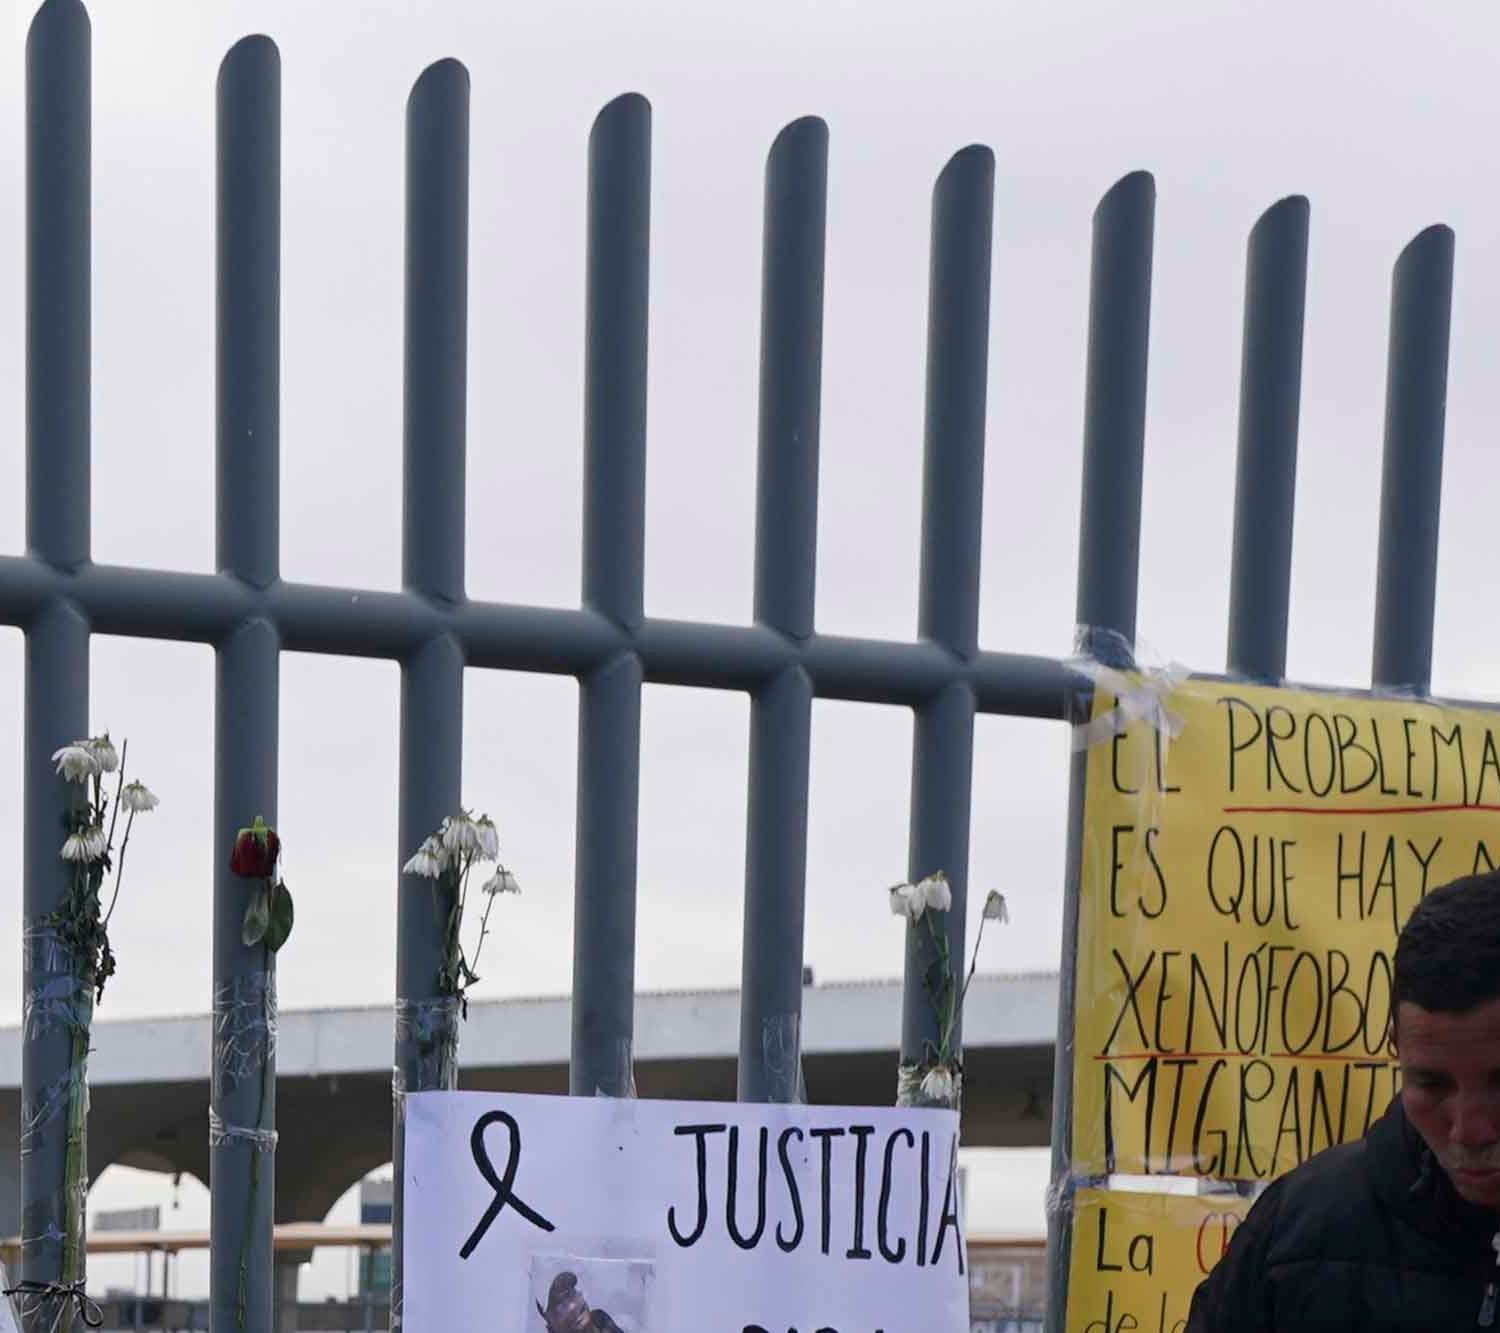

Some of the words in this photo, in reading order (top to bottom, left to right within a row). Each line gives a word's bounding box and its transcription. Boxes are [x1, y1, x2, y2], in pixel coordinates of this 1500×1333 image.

[1110, 696, 1181, 796] EL
[1109, 824, 1168, 921] ES
[1206, 825, 1300, 931] QUE
[1337, 830, 1444, 937] HAY
[1102, 941, 1399, 1058] XENÓFOBO
[666, 1124, 966, 1276] JUSTICIA
[1095, 1207, 1155, 1276] La
